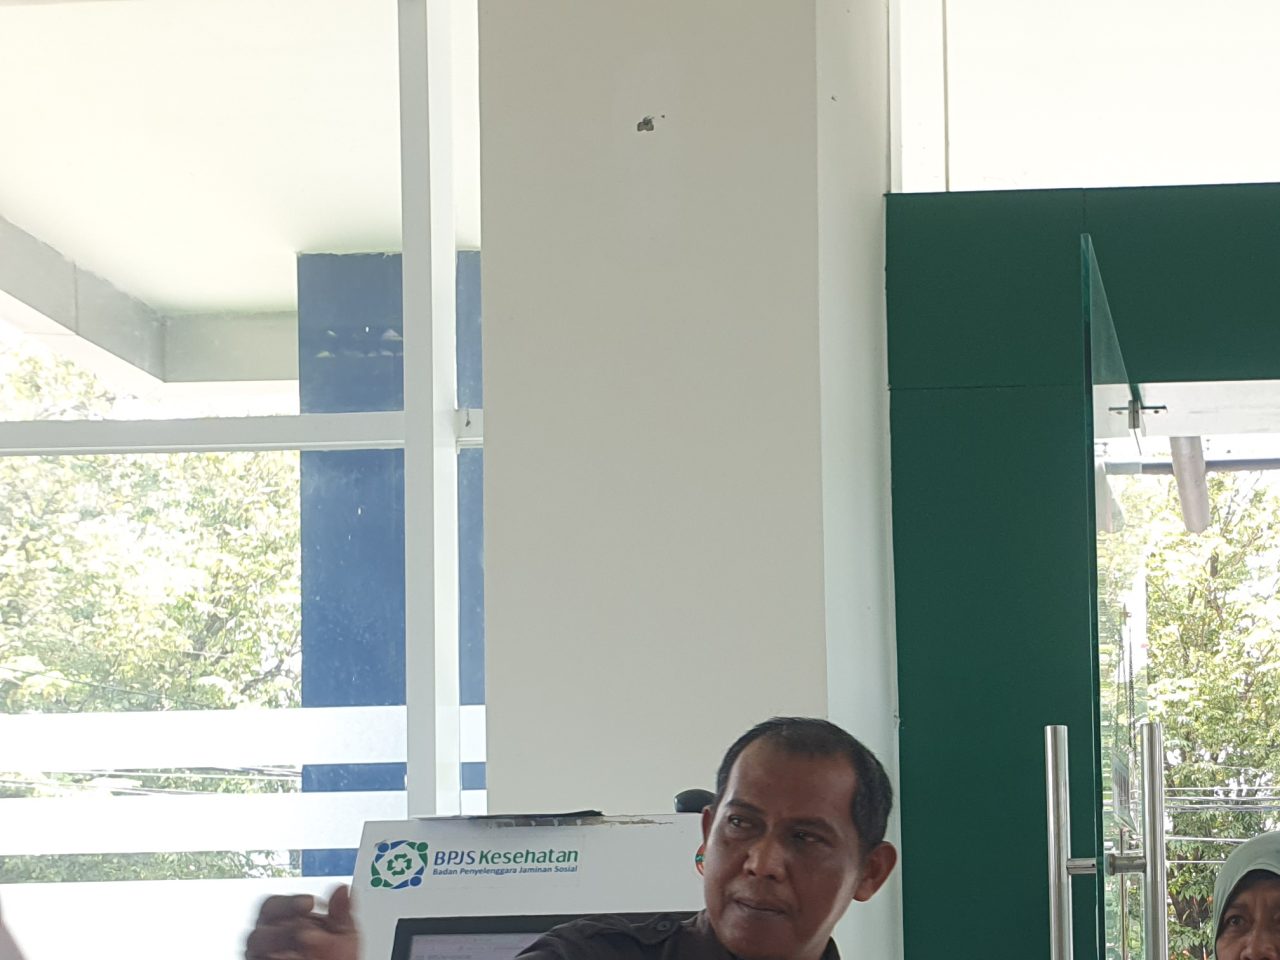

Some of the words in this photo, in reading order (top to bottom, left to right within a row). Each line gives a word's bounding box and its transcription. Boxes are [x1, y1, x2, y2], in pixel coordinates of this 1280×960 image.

[434, 850, 476, 866] BPJS
[479, 849, 579, 865] Kesehatan
[433, 868, 458, 876] Badan
[459, 867, 517, 876] Penyelenggara
[519, 866, 552, 874] Jaminan
[554, 865, 578, 873] Sosial
